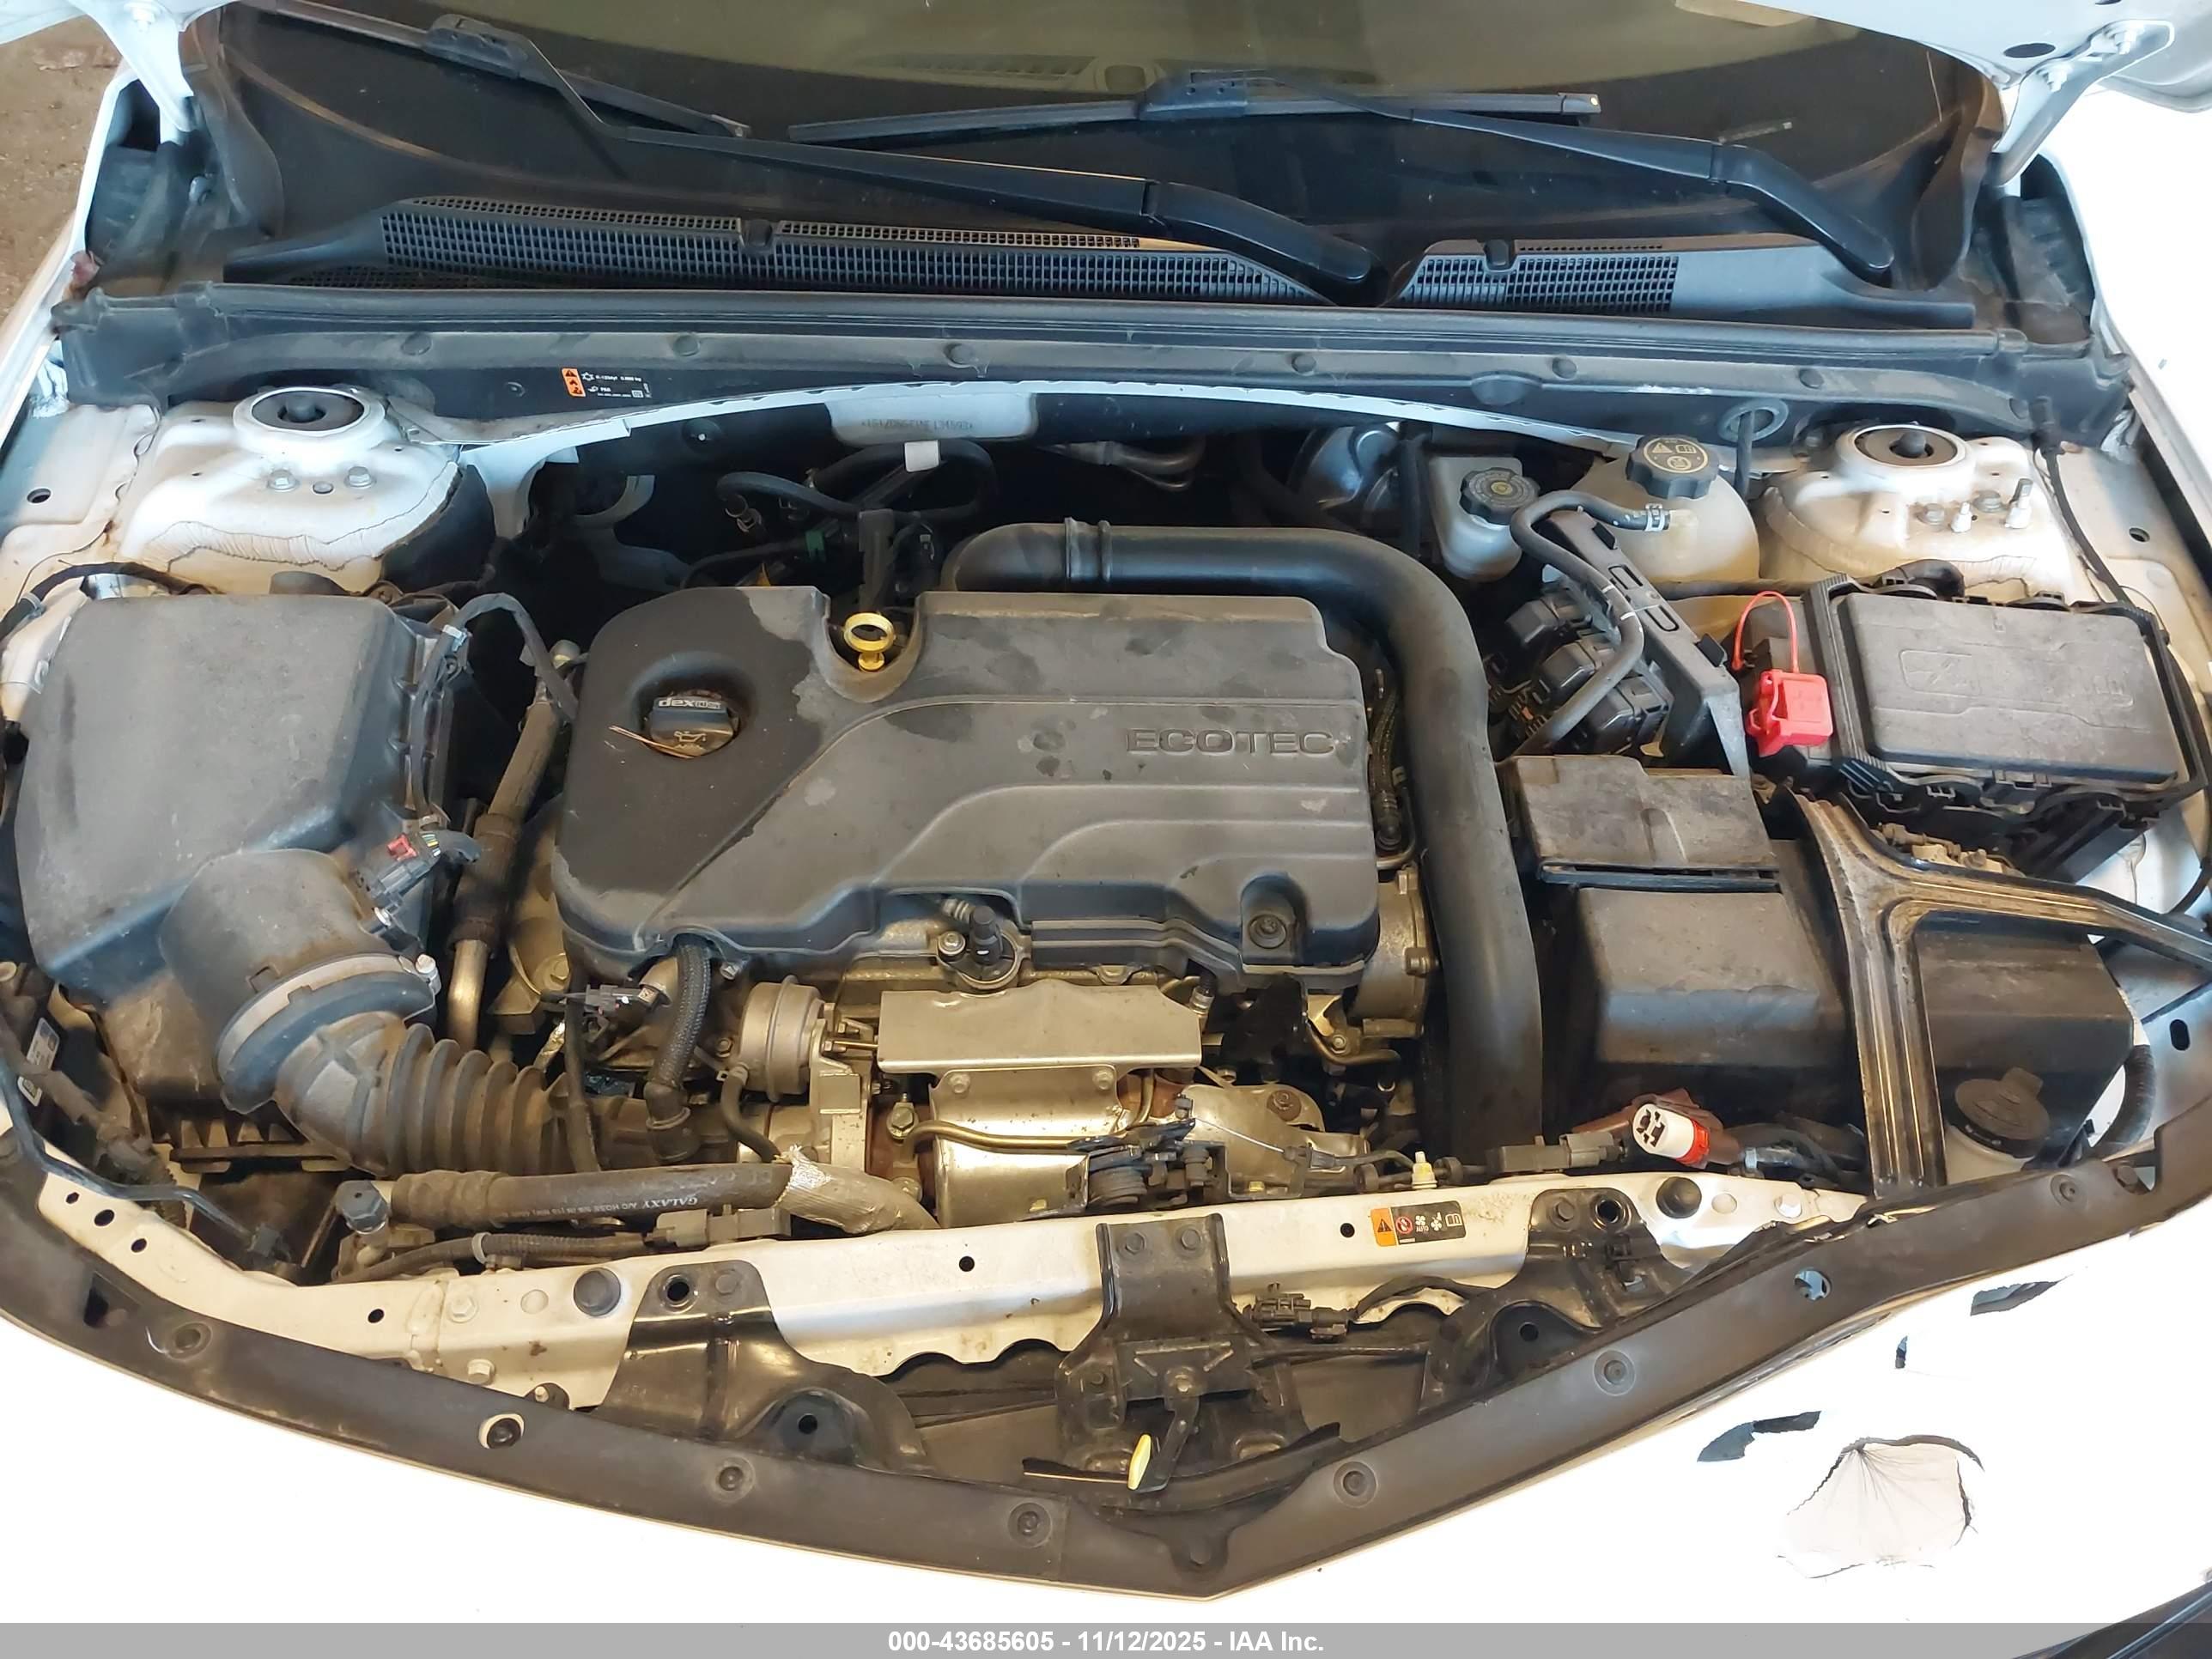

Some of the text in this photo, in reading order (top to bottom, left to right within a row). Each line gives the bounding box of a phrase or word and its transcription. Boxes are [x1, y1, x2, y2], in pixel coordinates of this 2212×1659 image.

[658, 697, 721, 710] dexos
[1126, 729, 1335, 757] ECOTEC
[643, 1196, 699, 1208] GALAXY
